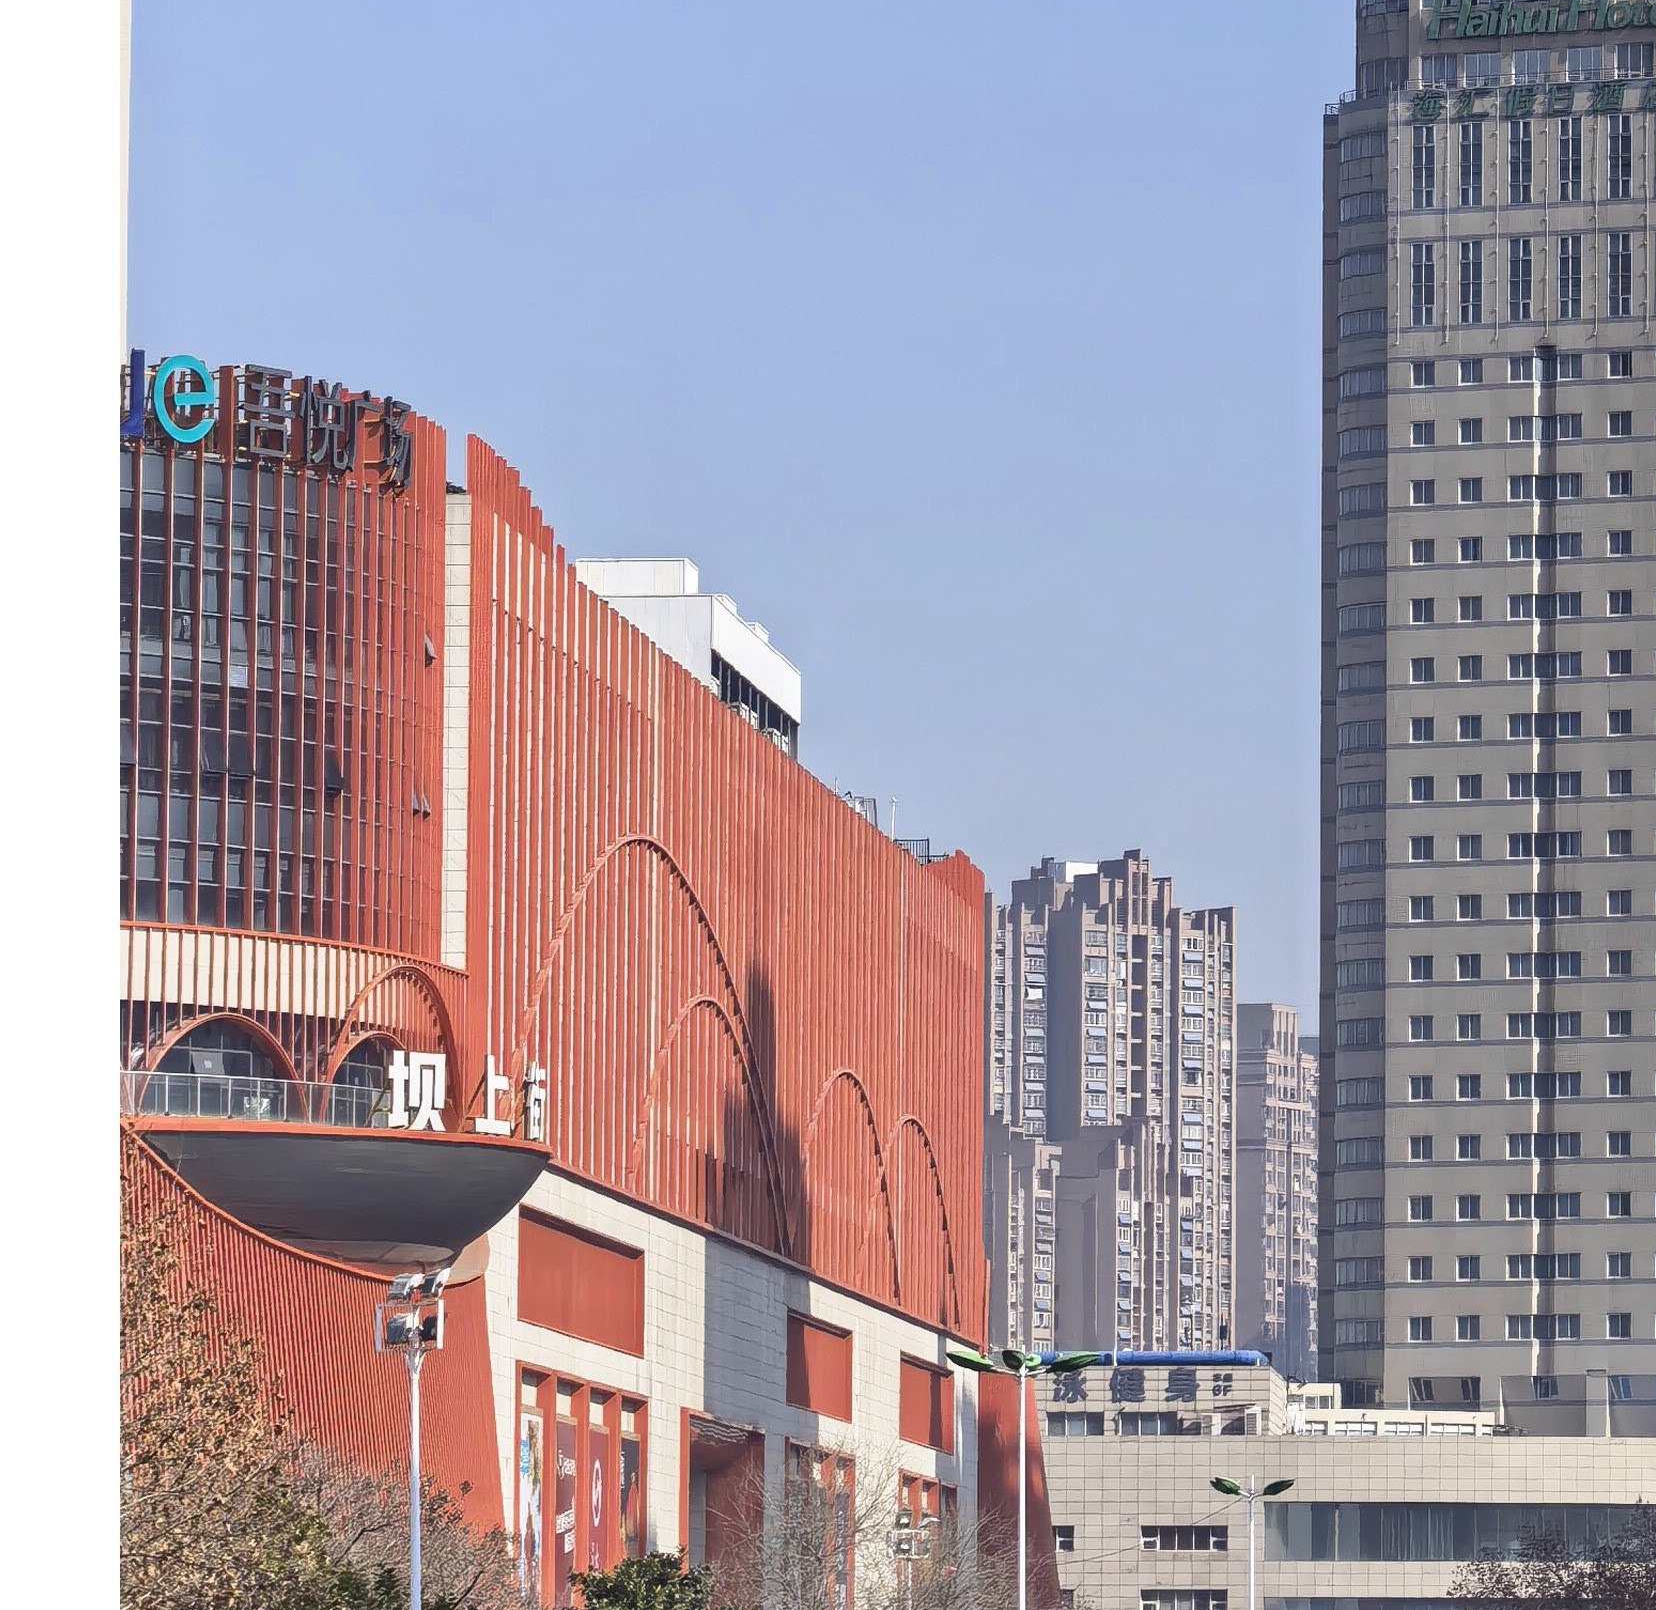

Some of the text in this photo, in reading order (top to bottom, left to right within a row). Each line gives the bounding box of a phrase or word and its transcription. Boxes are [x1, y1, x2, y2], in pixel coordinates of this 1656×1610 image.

[240, 363, 413, 491] 吾悦广场
[387, 1049, 548, 1143] 坝上街
